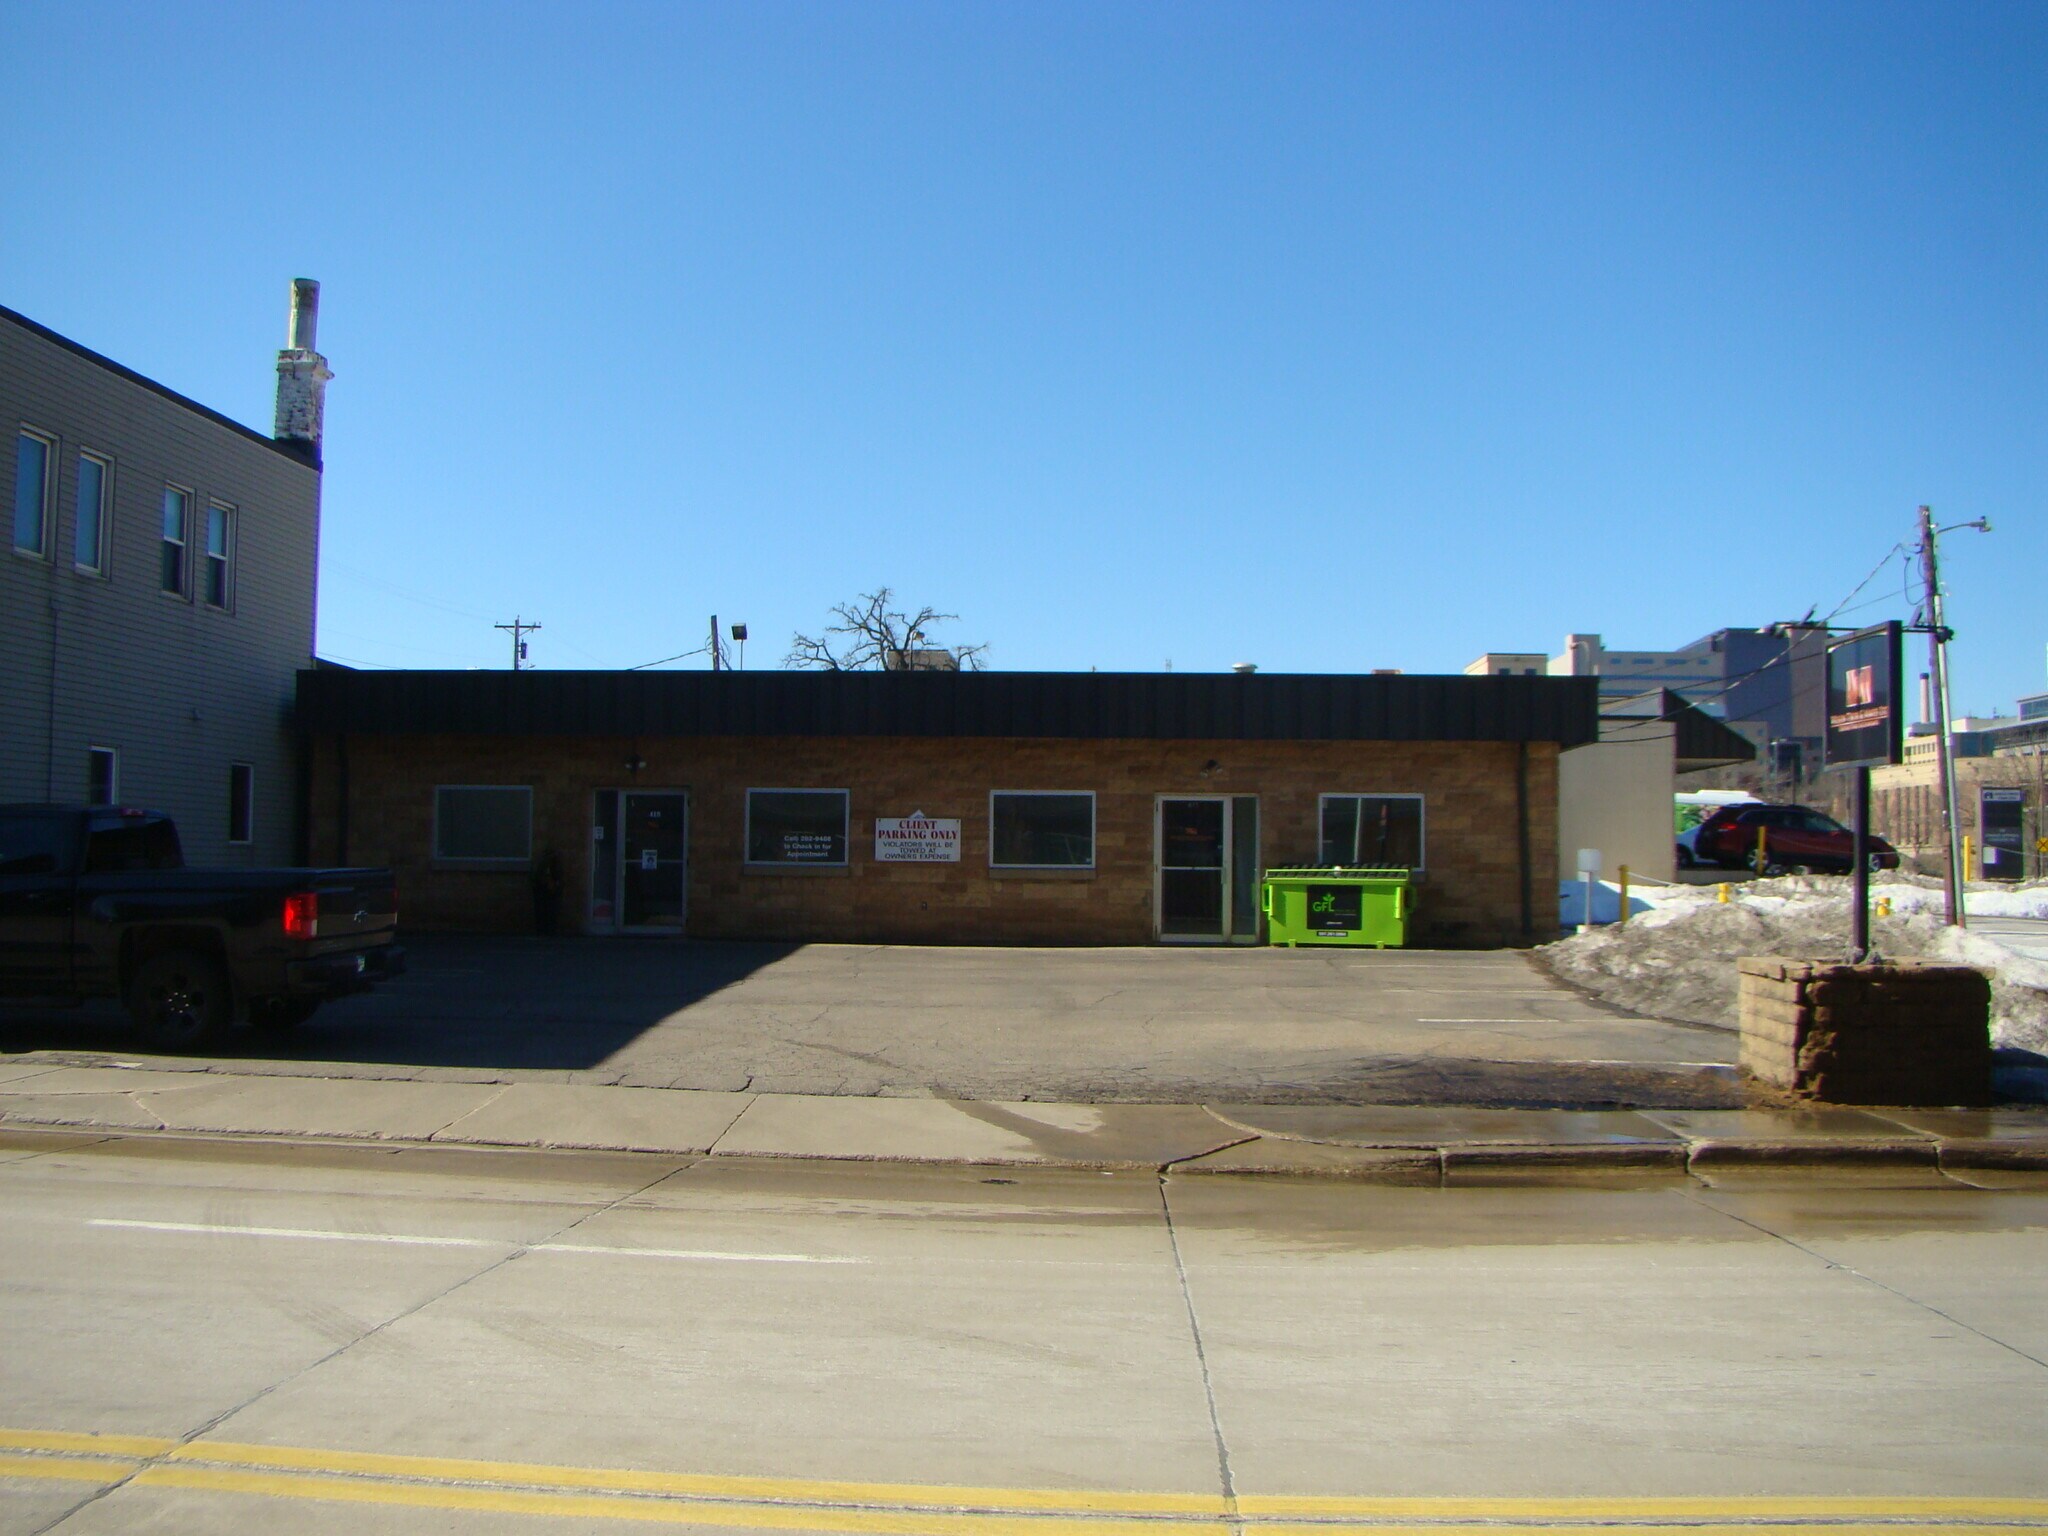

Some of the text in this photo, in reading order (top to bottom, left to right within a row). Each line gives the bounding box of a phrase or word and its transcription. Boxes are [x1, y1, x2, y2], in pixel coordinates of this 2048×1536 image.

[898, 820, 937, 829] CLIENT
[878, 830, 958, 839] PARKING ONLY
[1313, 898, 1335, 912] GFL
